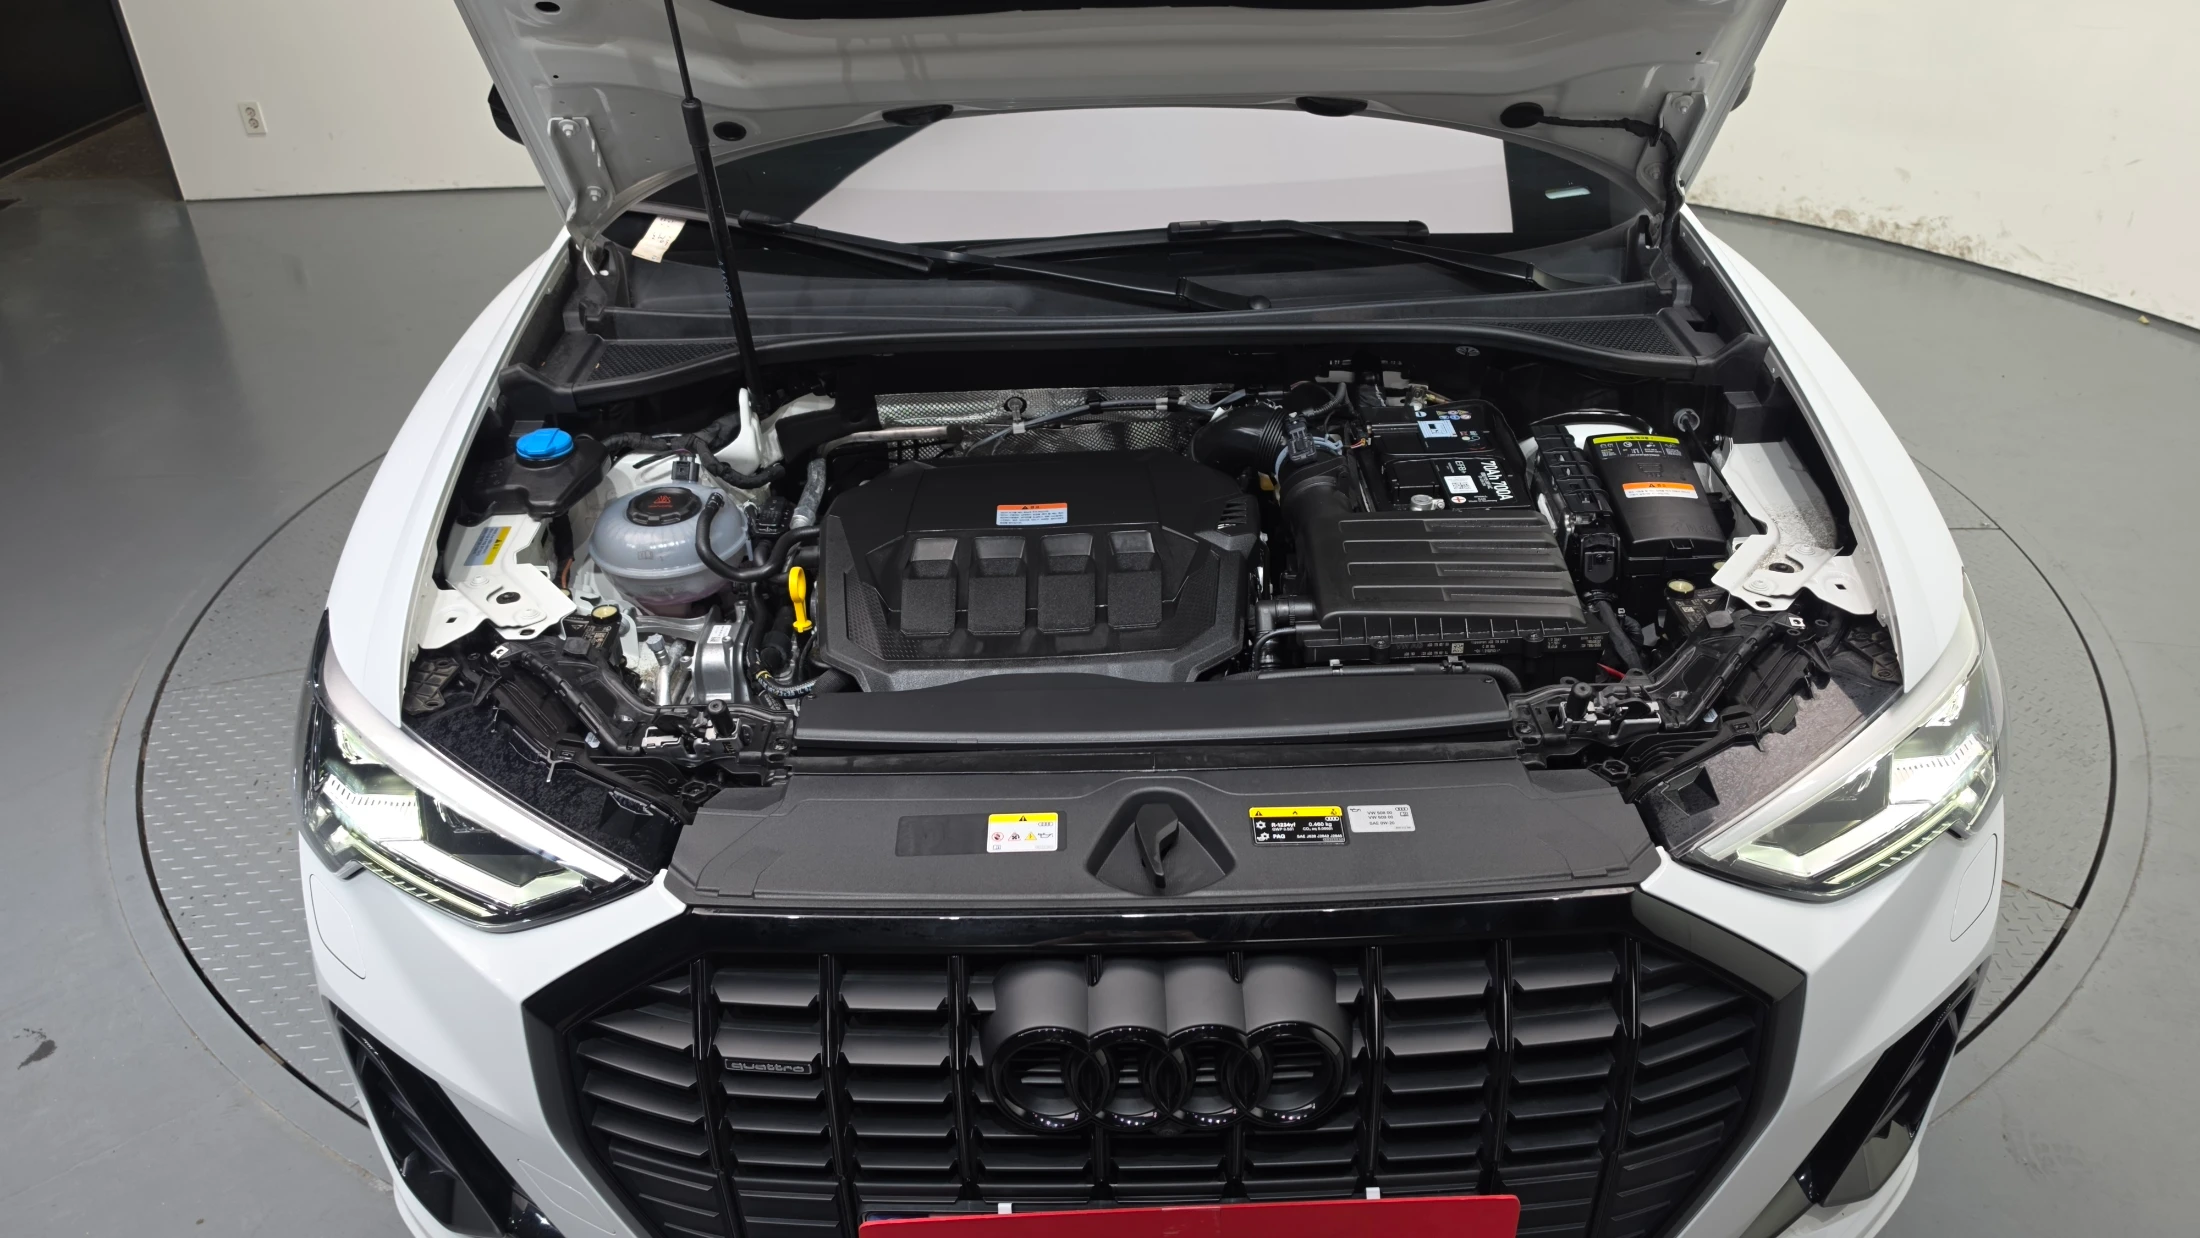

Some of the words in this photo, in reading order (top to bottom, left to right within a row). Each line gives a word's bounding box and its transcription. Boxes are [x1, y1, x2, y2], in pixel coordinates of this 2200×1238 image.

[1481, 461, 1502, 480] 70Ah
[1492, 479, 1513, 501] 700A
[731, 1062, 805, 1072] quattro
